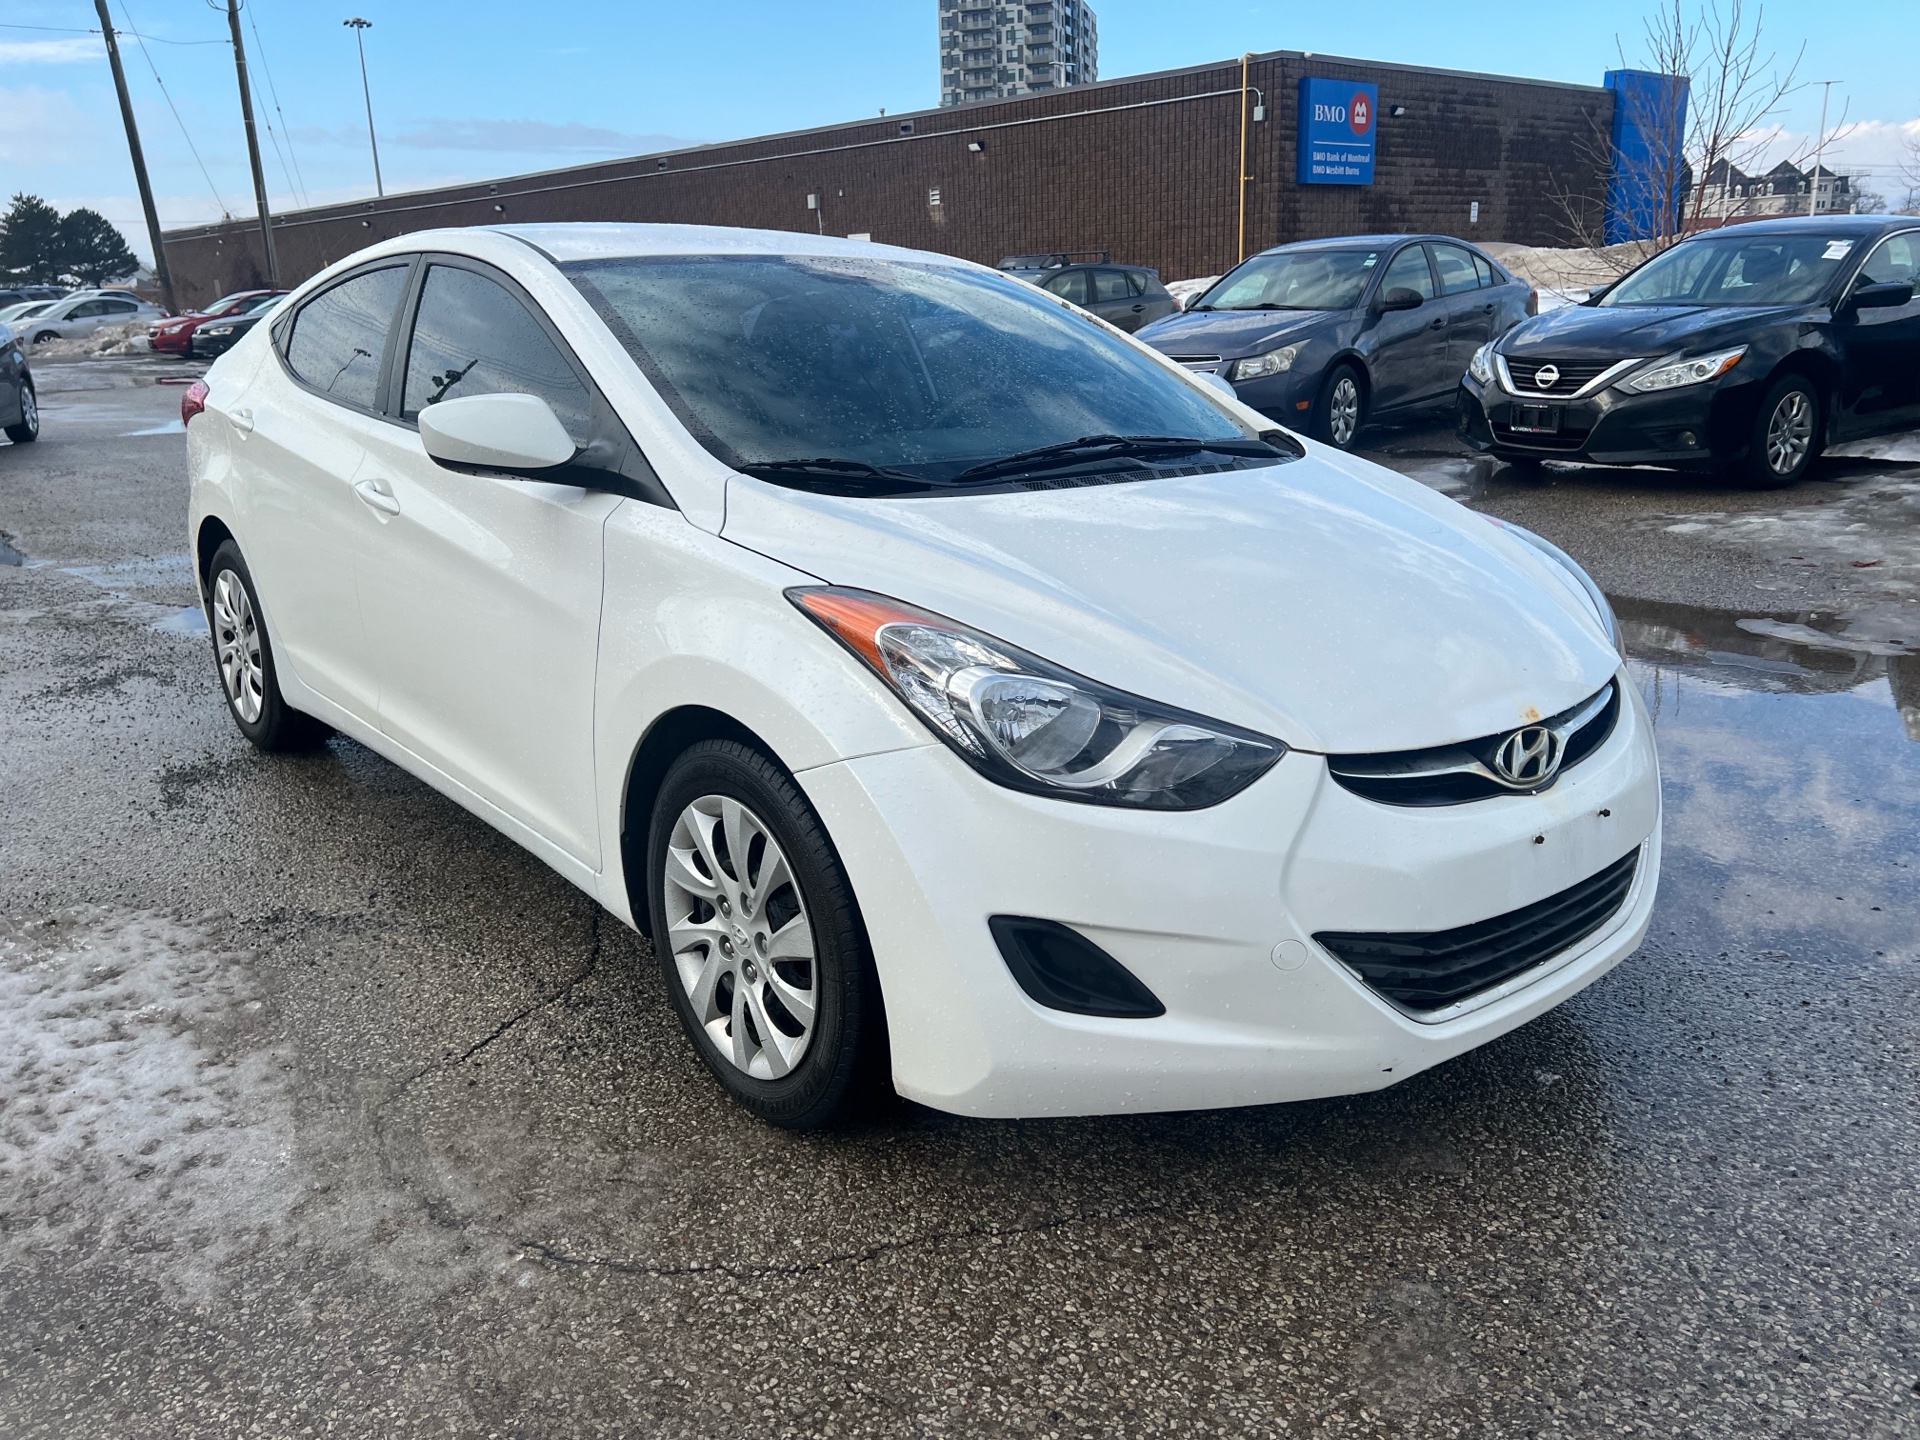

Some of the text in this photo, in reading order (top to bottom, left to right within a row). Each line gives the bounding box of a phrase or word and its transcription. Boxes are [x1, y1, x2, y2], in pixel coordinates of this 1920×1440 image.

[1314, 104, 1346, 123] BMO
[1313, 151, 1371, 163] BMO Bank of Montreal
[1312, 165, 1360, 175] BMO Nesbitt Burns
